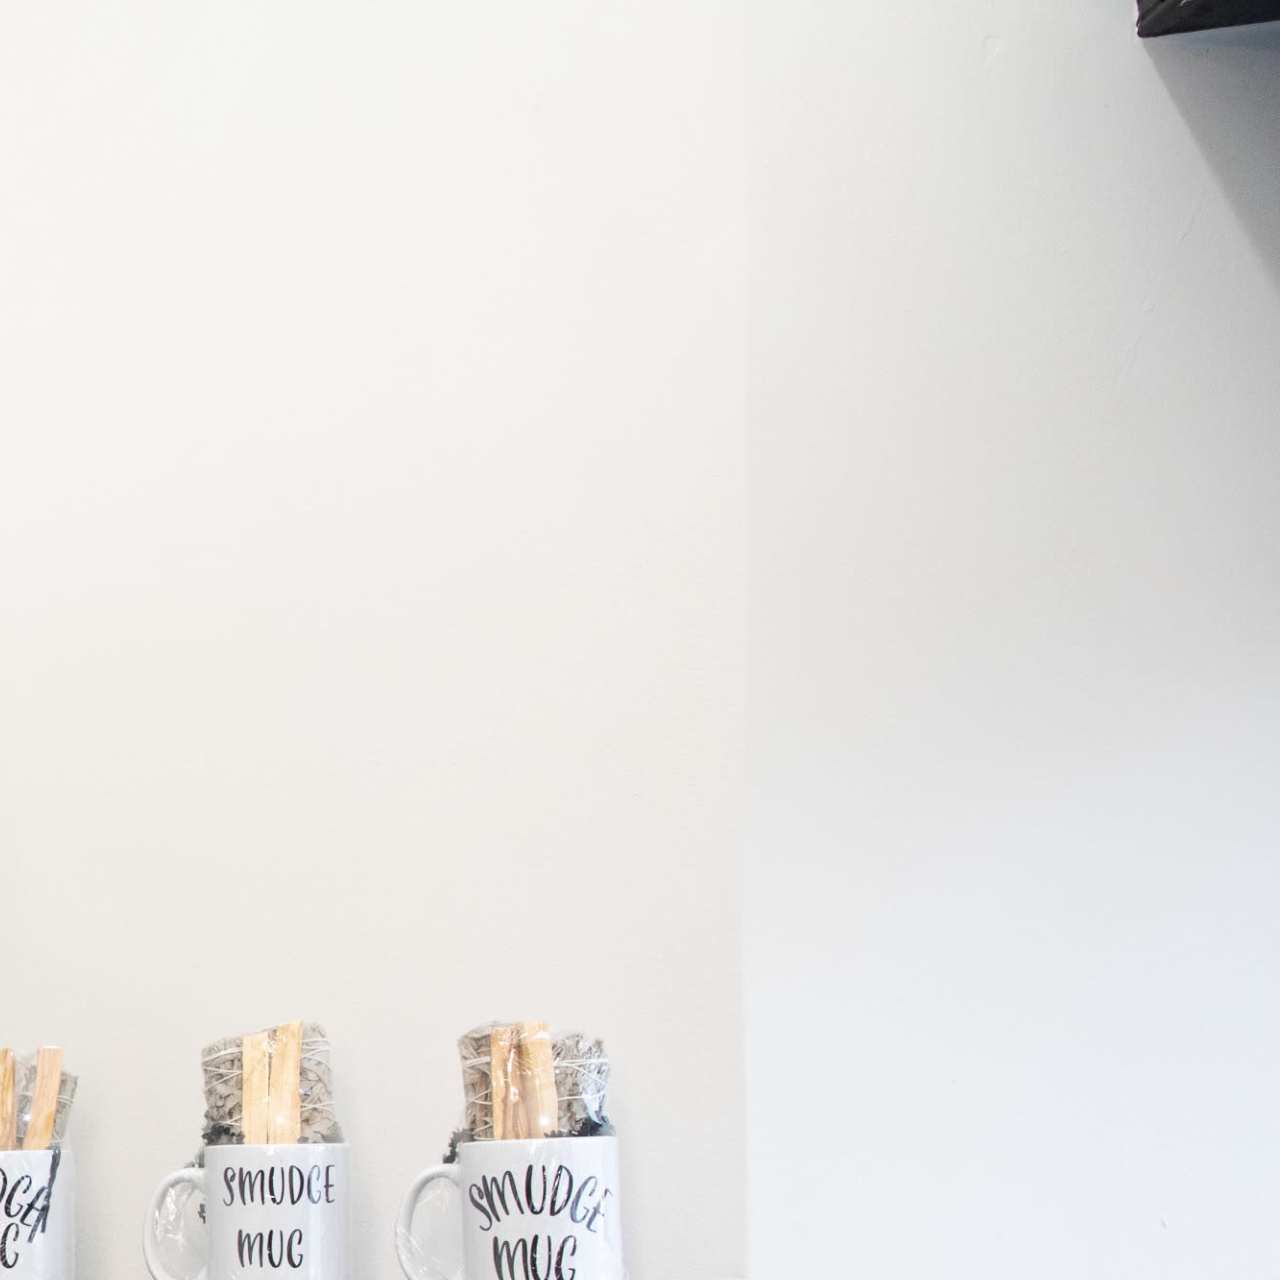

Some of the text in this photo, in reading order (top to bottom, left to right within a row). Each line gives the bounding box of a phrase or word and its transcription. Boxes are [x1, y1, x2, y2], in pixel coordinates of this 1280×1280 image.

[222, 1164, 336, 1207] SMUDGE
[468, 1163, 614, 1233] SMUDGE
[237, 1228, 305, 1269] MUG
